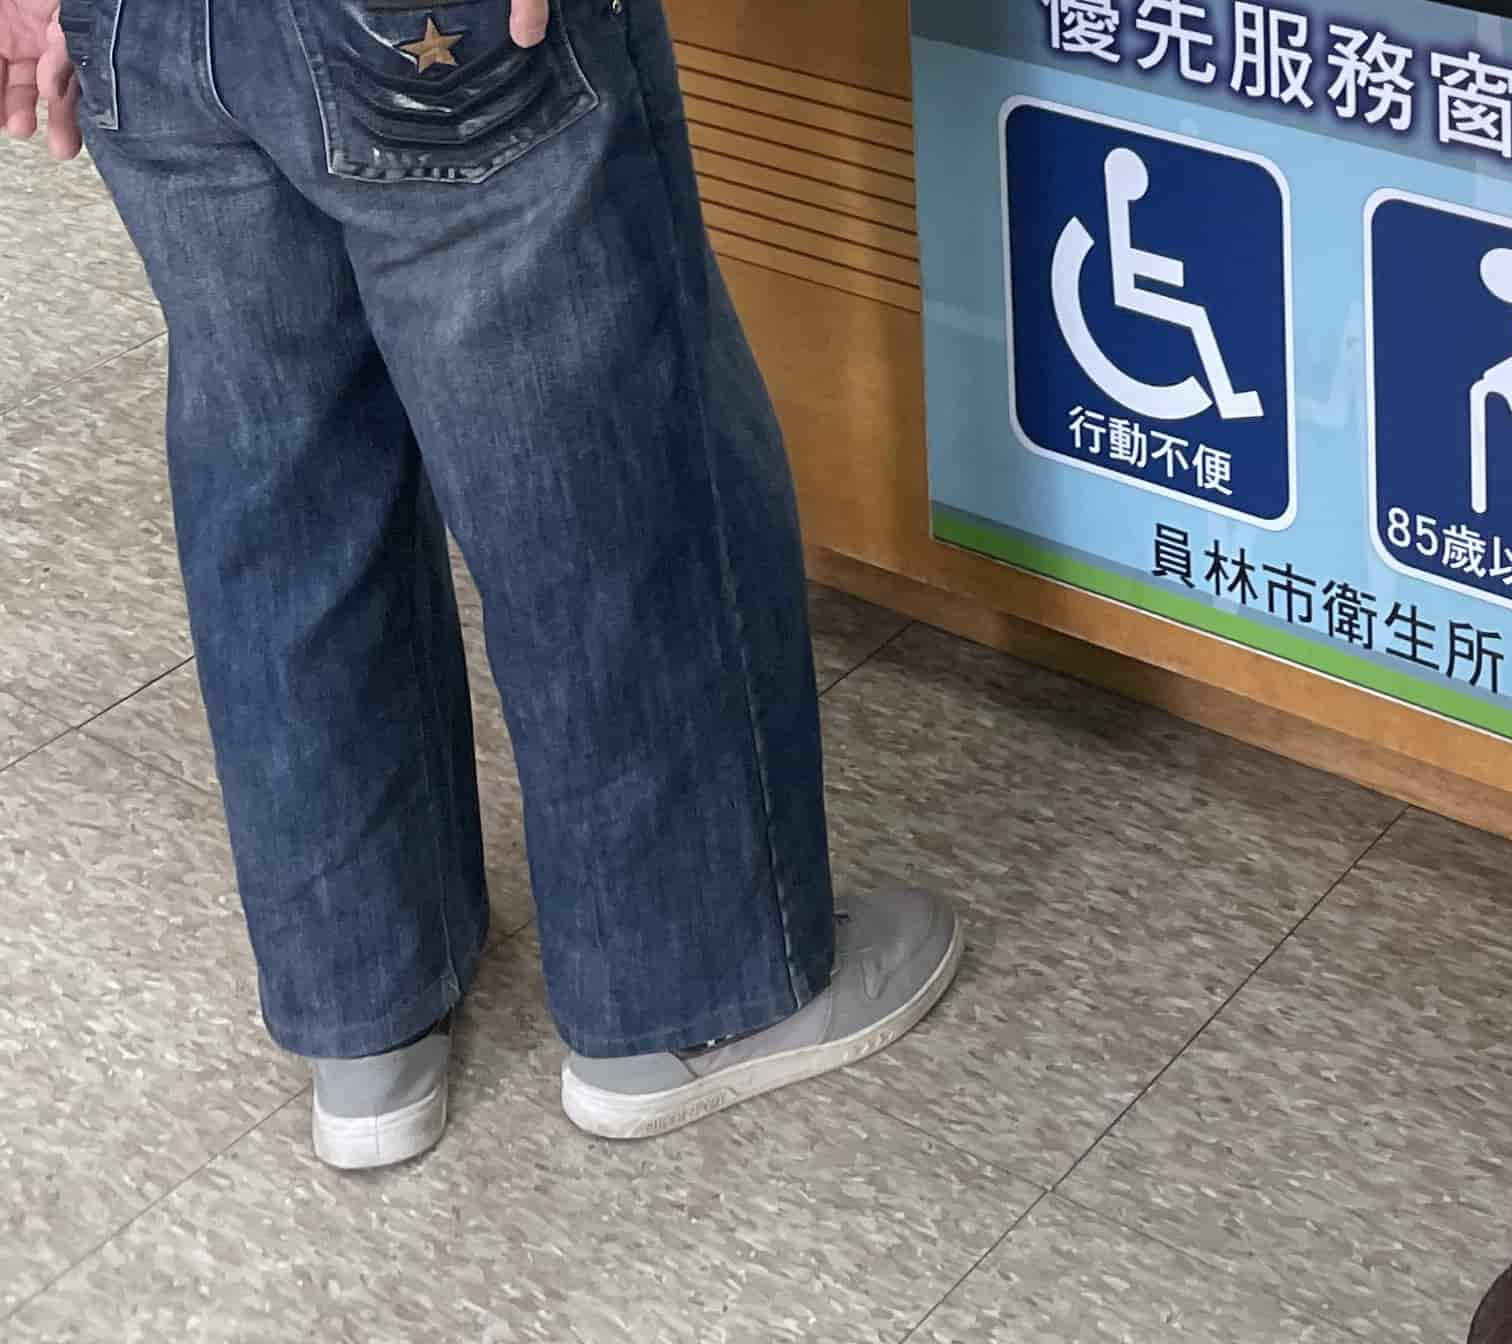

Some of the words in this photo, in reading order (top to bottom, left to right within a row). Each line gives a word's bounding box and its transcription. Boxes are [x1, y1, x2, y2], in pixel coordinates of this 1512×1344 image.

[1068, 405, 1233, 496] 行動不便
[1149, 522, 1506, 694] 員林市衛生所
